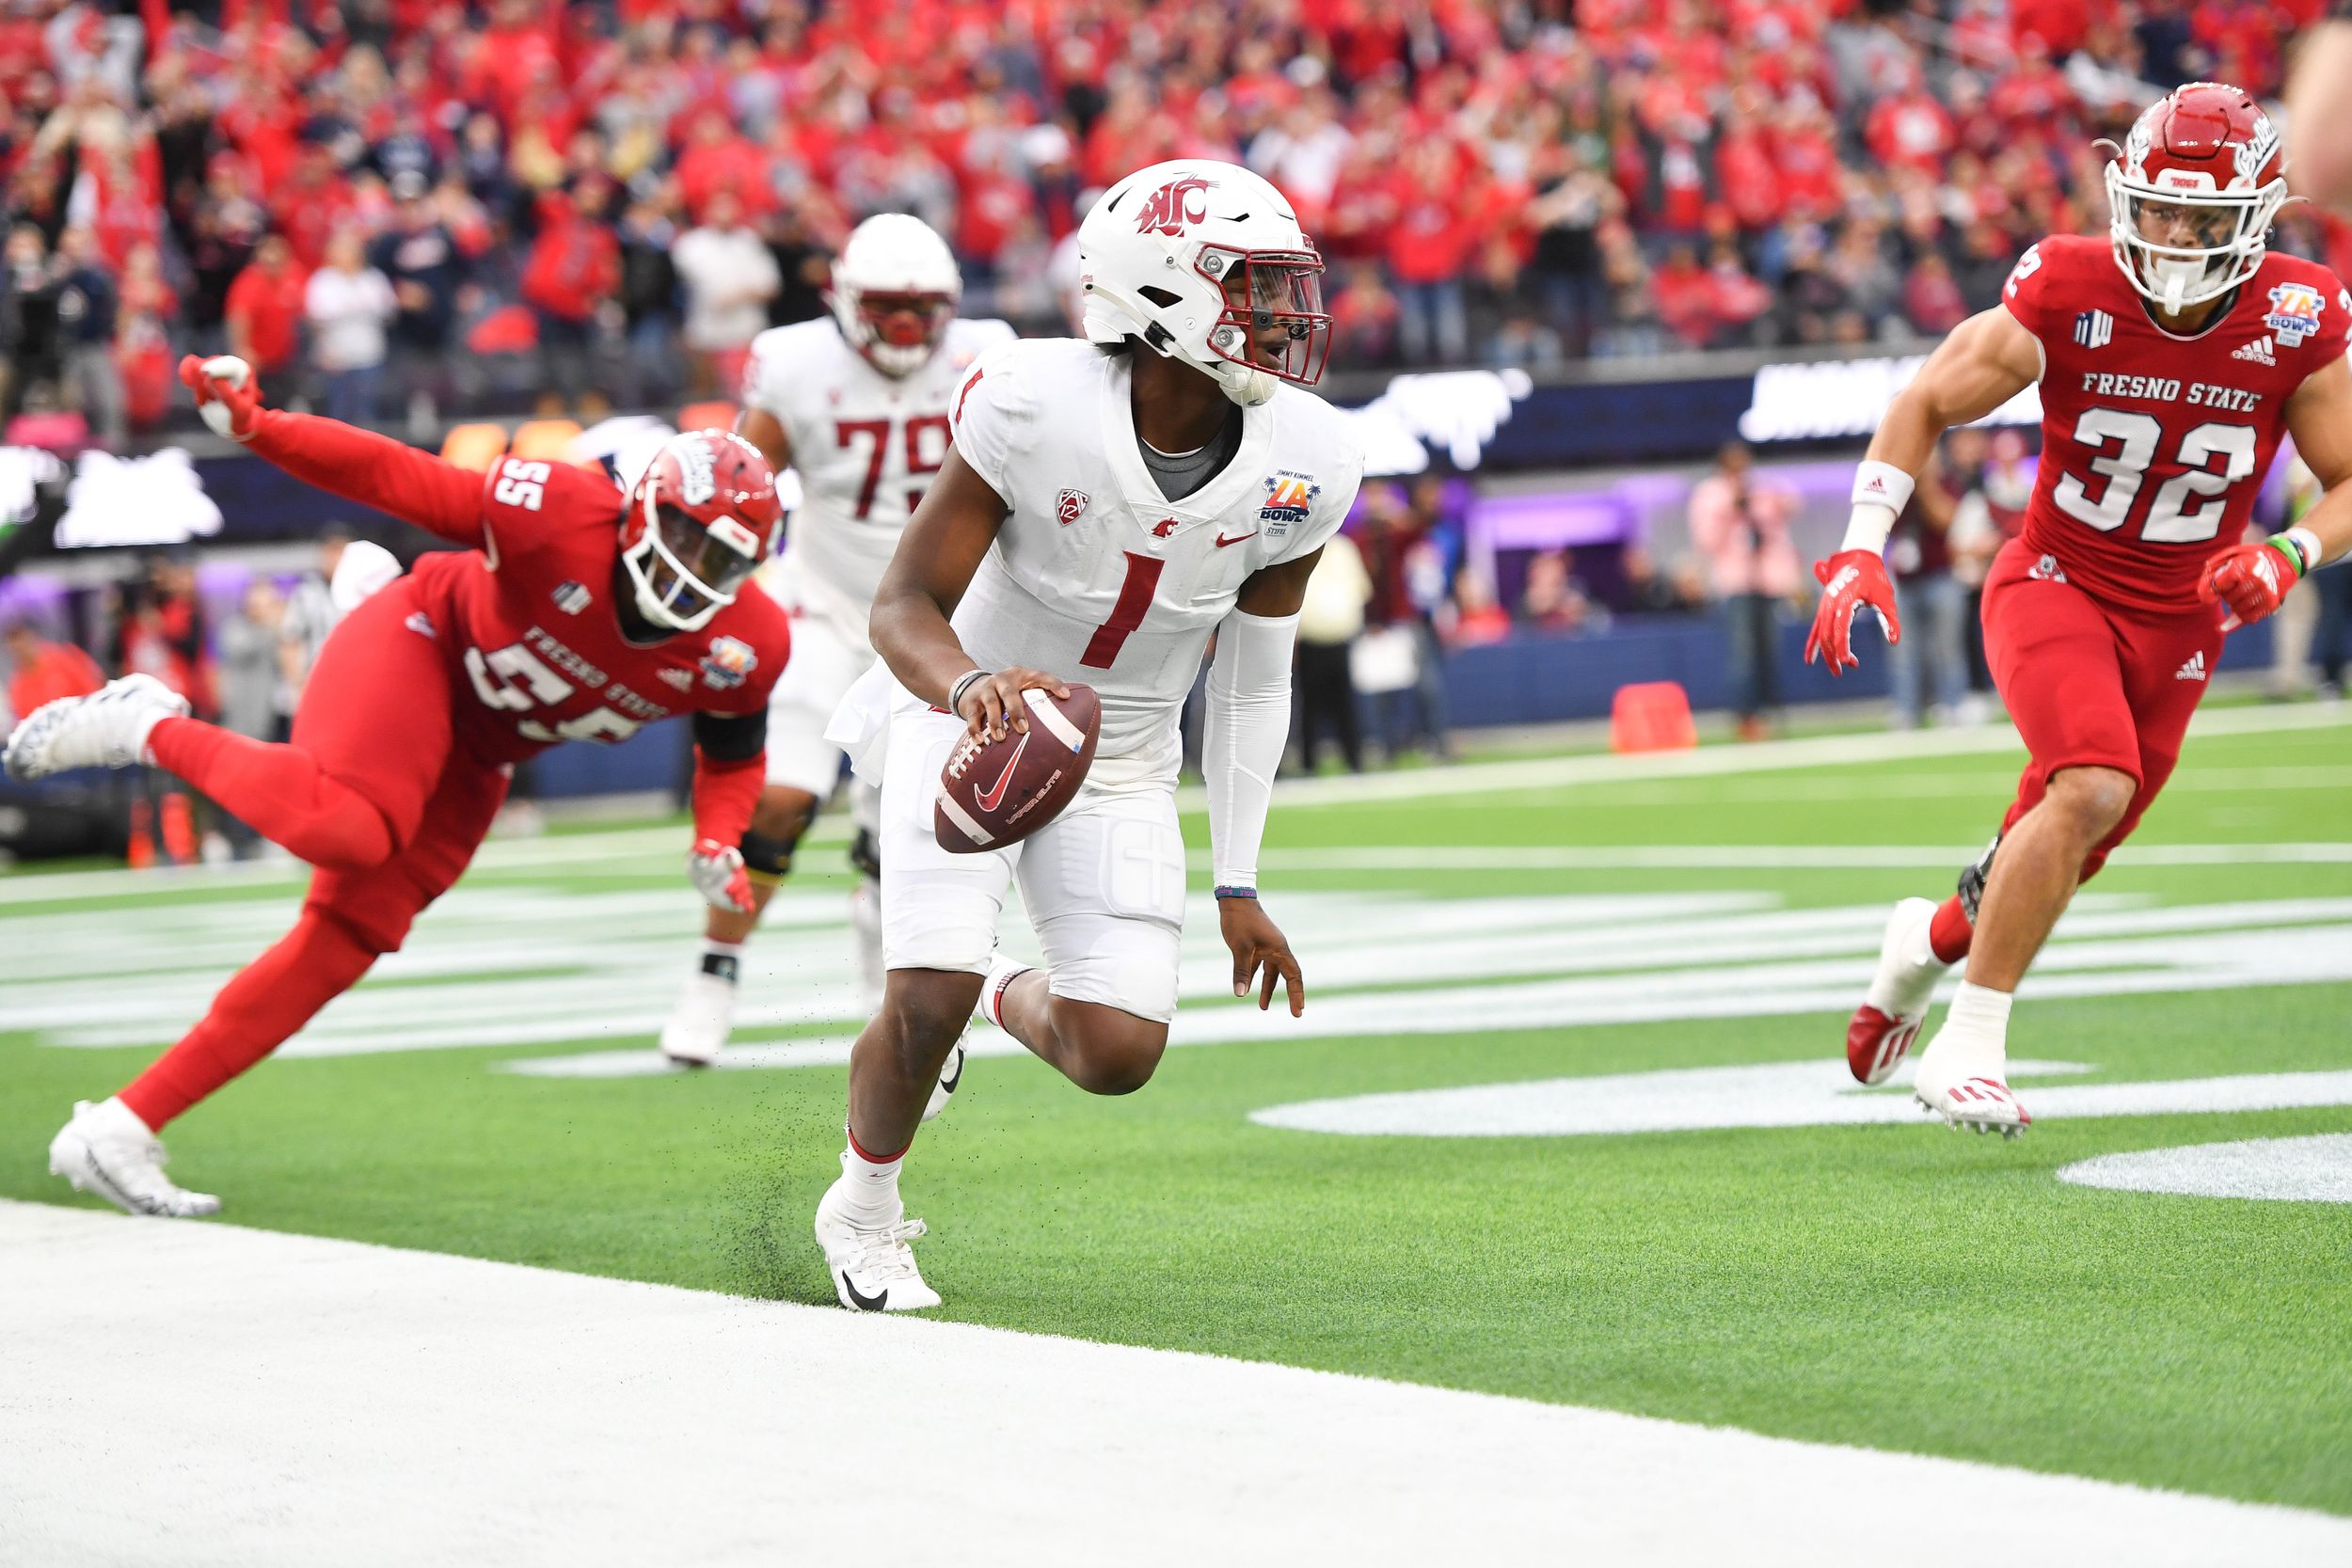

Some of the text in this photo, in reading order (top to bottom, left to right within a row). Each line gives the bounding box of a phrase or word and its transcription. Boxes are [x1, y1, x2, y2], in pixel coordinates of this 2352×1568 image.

[2081, 372, 2182, 412] FRESNO
[2185, 382, 2263, 412] STATE
[835, 415, 954, 519] 79
[1276, 469, 1314, 483] JIMMY KIMMEL
[2054, 405, 2257, 543] 32
[494, 457, 552, 512] 55
[1264, 479, 1309, 510] LA
[1058, 489, 1089, 514] PAC
[1060, 503, 1079, 519] 12
[1259, 509, 1305, 523] BOWL
[1265, 527, 1287, 535] STIFEL
[1078, 550, 1166, 670] 1
[1036, 768, 1062, 800] ELITE
